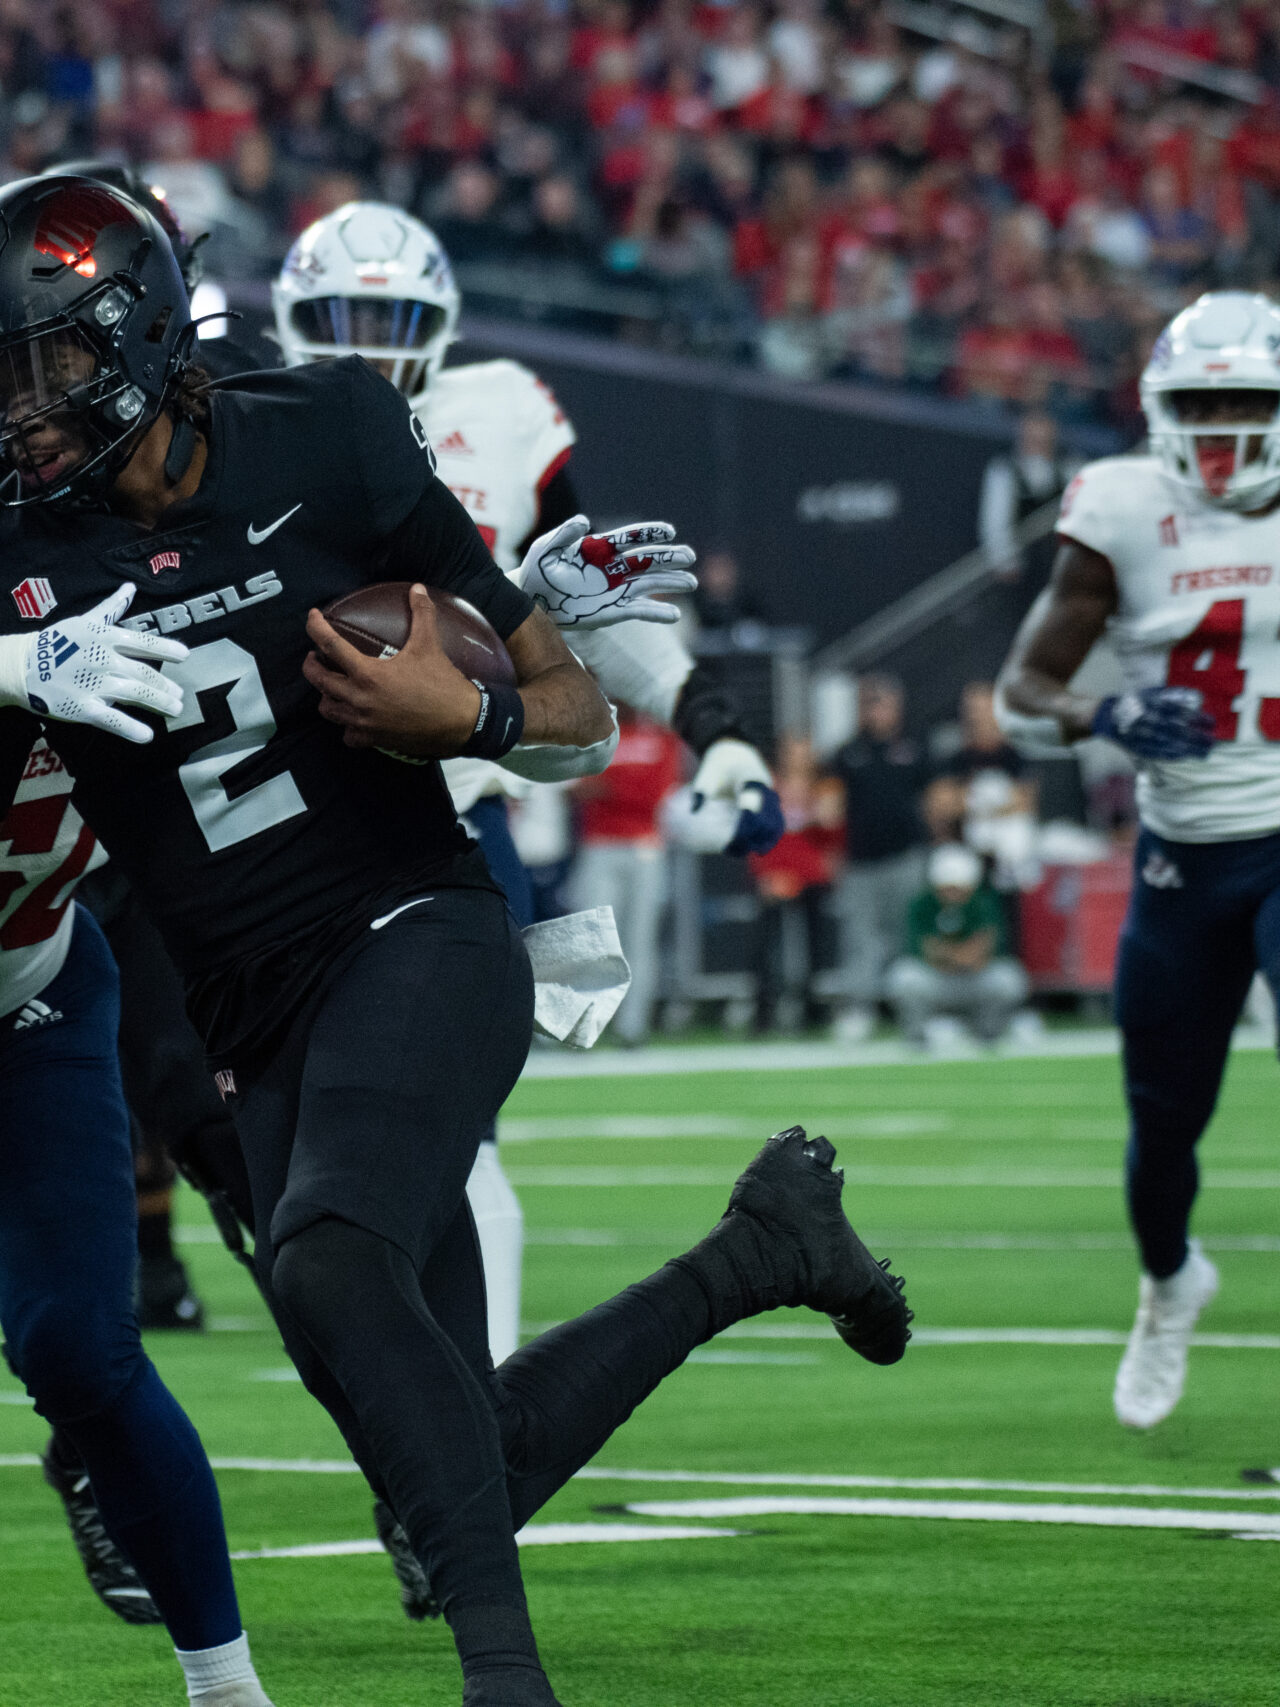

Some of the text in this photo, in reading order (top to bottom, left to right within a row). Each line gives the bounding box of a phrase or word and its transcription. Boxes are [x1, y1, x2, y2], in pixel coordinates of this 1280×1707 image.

[149, 551, 181, 575] UNLV
[1172, 565, 1272, 595] FRESNO
[120, 569, 283, 637] EBELS
[37, 631, 52, 682] adidas
[1167, 598, 1280, 742] 4
[160, 637, 309, 854] 2
